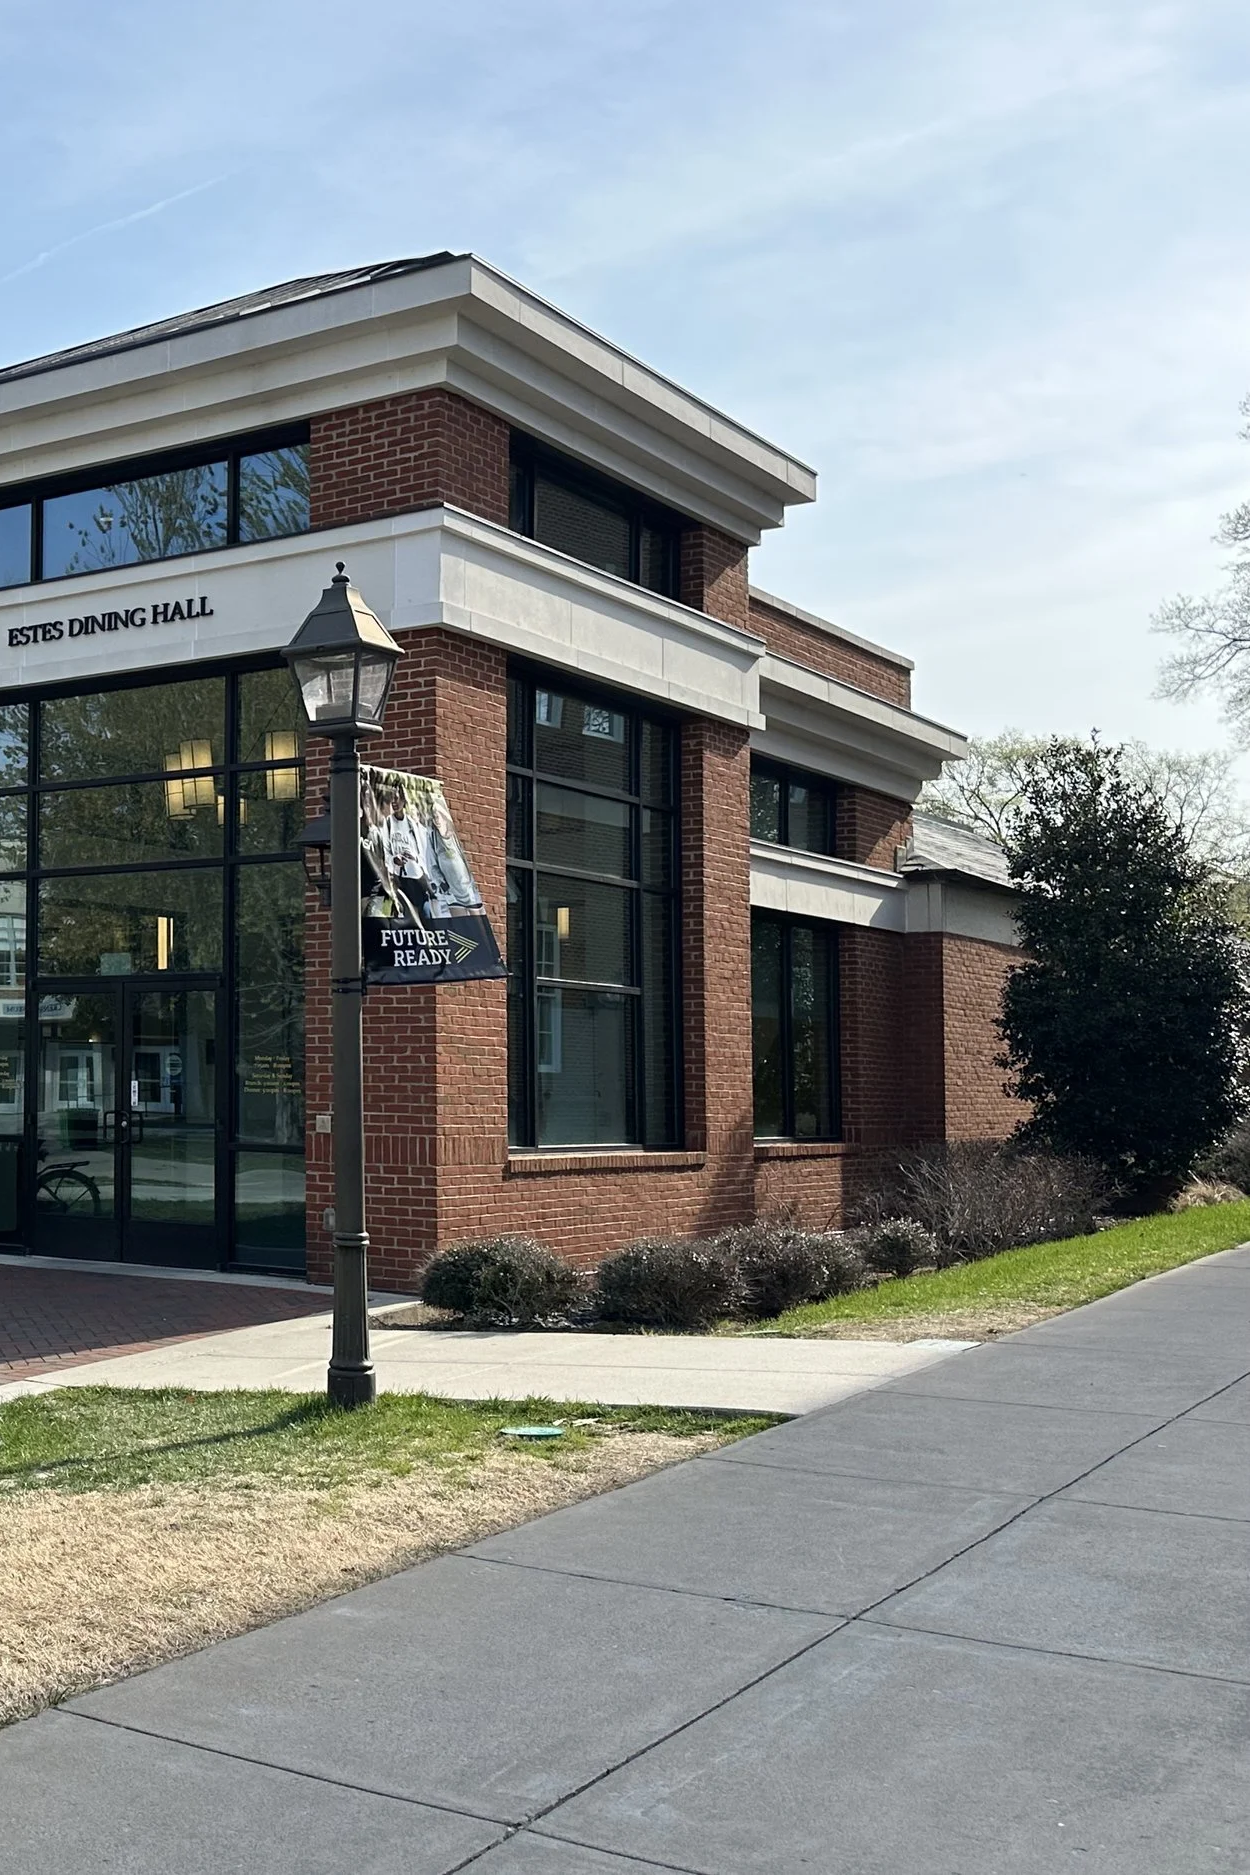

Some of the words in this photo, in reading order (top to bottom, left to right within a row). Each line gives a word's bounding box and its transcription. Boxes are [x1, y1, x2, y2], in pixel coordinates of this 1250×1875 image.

[7, 621, 64, 647] ESTES
[68, 607, 146, 637] DINING
[151, 596, 214, 625] HALL
[380, 929, 449, 947] FUTURE
[394, 949, 452, 967] READY
